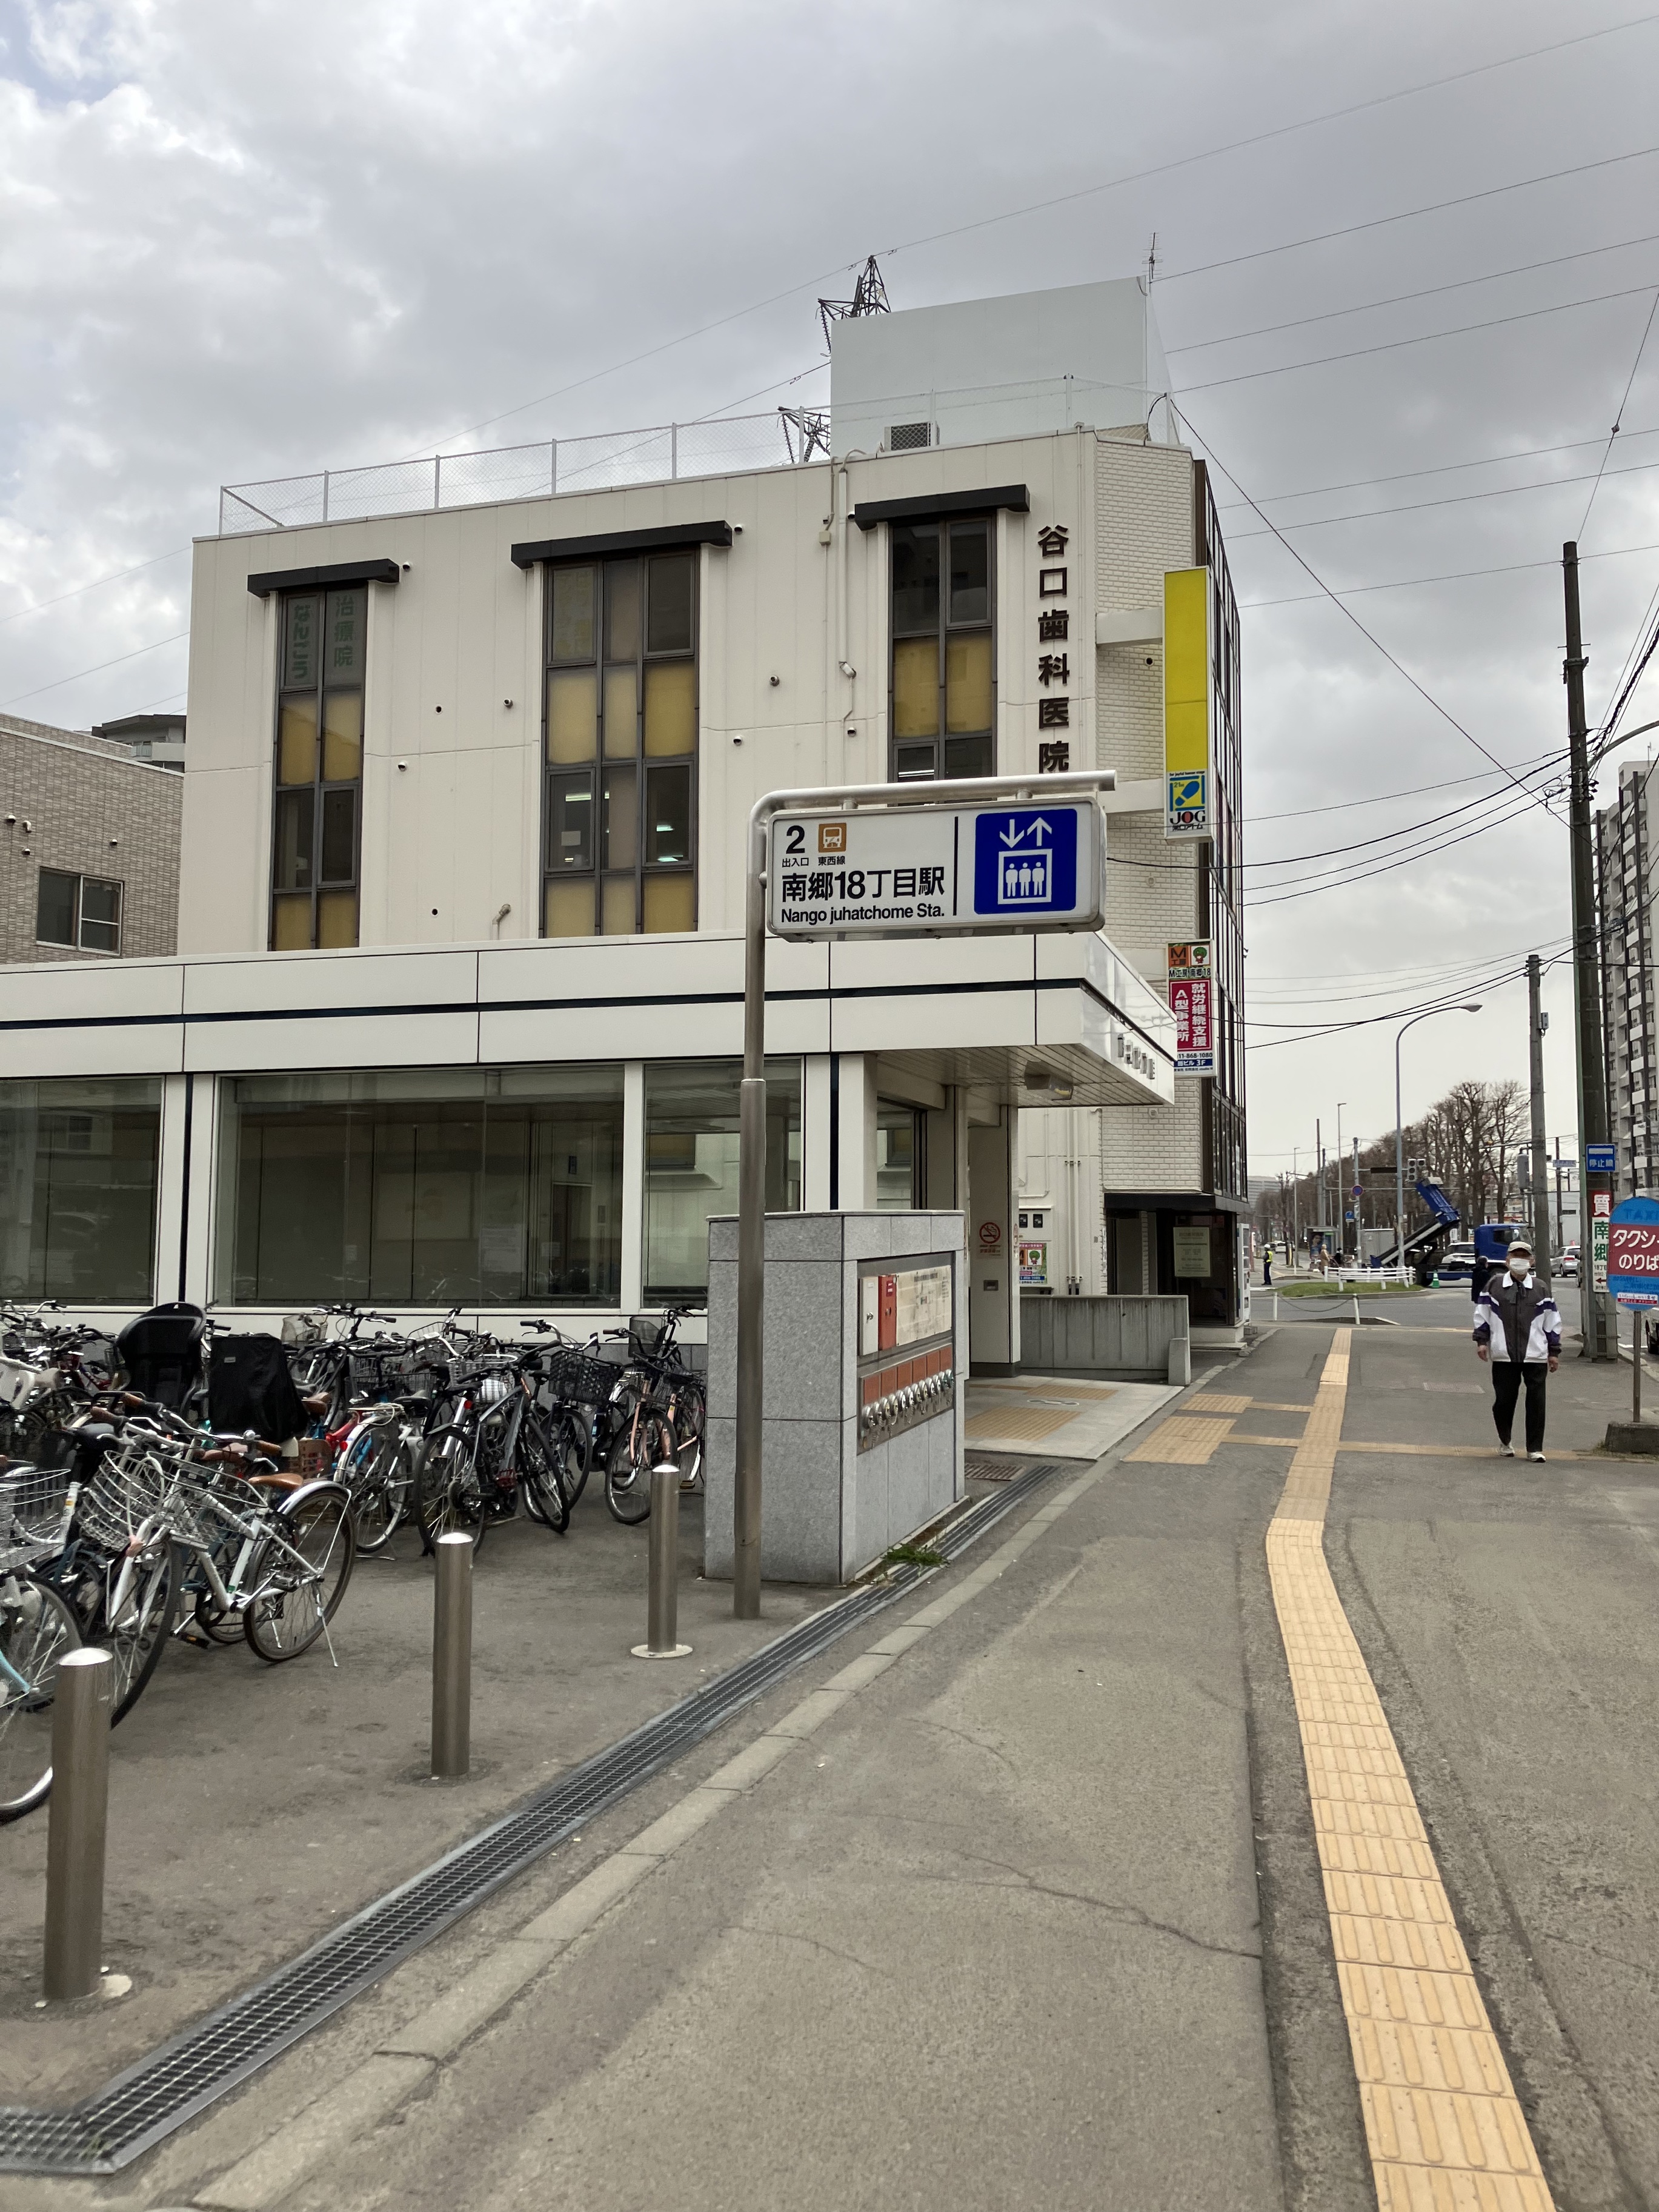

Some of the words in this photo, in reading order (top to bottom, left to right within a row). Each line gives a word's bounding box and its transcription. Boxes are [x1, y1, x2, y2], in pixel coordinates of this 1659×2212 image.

[1038, 525, 1069, 774] 谷口歯科医院
[1169, 810, 1206, 825] JOG
[786, 825, 805, 854] 2
[782, 857, 810, 868] 出入口
[818, 855, 846, 866] 東西線
[782, 866, 945, 903] 南郷18丁目駅
[782, 908, 827, 925] Nango
[830, 905, 914, 925] juhatchome
[917, 903, 945, 917] Sta.
[1171, 948, 1186, 958] M
[1189, 968, 1211, 977] 南郷18
[1175, 989, 1190, 1042] A型事業所
[1192, 983, 1207, 1047] 就労継続支援
[1594, 1194, 1610, 1216] 質
[1594, 1220, 1609, 1261] 南郷
[1613, 1229, 1659, 1248] タクシ
[1619, 1254, 1659, 1270] のりば
